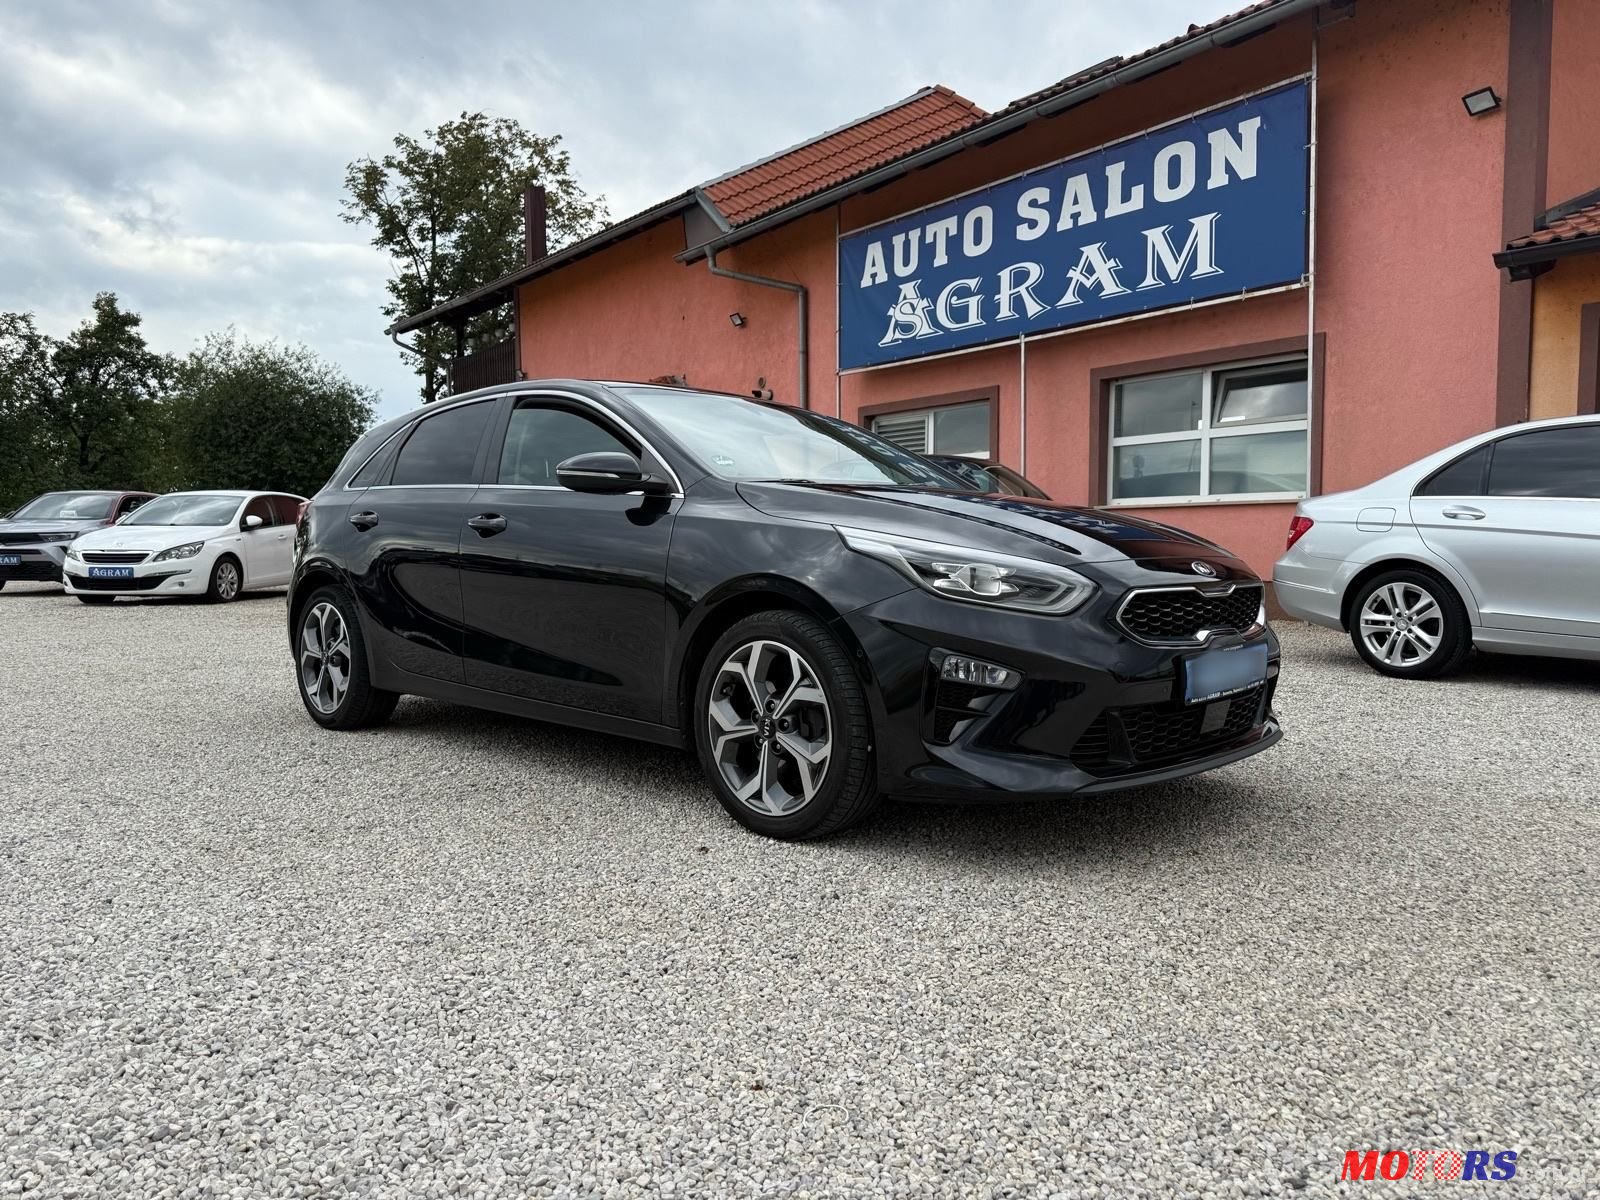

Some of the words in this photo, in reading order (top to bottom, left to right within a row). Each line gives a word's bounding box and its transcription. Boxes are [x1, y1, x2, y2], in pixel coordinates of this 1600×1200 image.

[860, 205, 993, 288] AUTO
[1016, 116, 1261, 241] SALON
[92, 567, 129, 577] AGRAM
